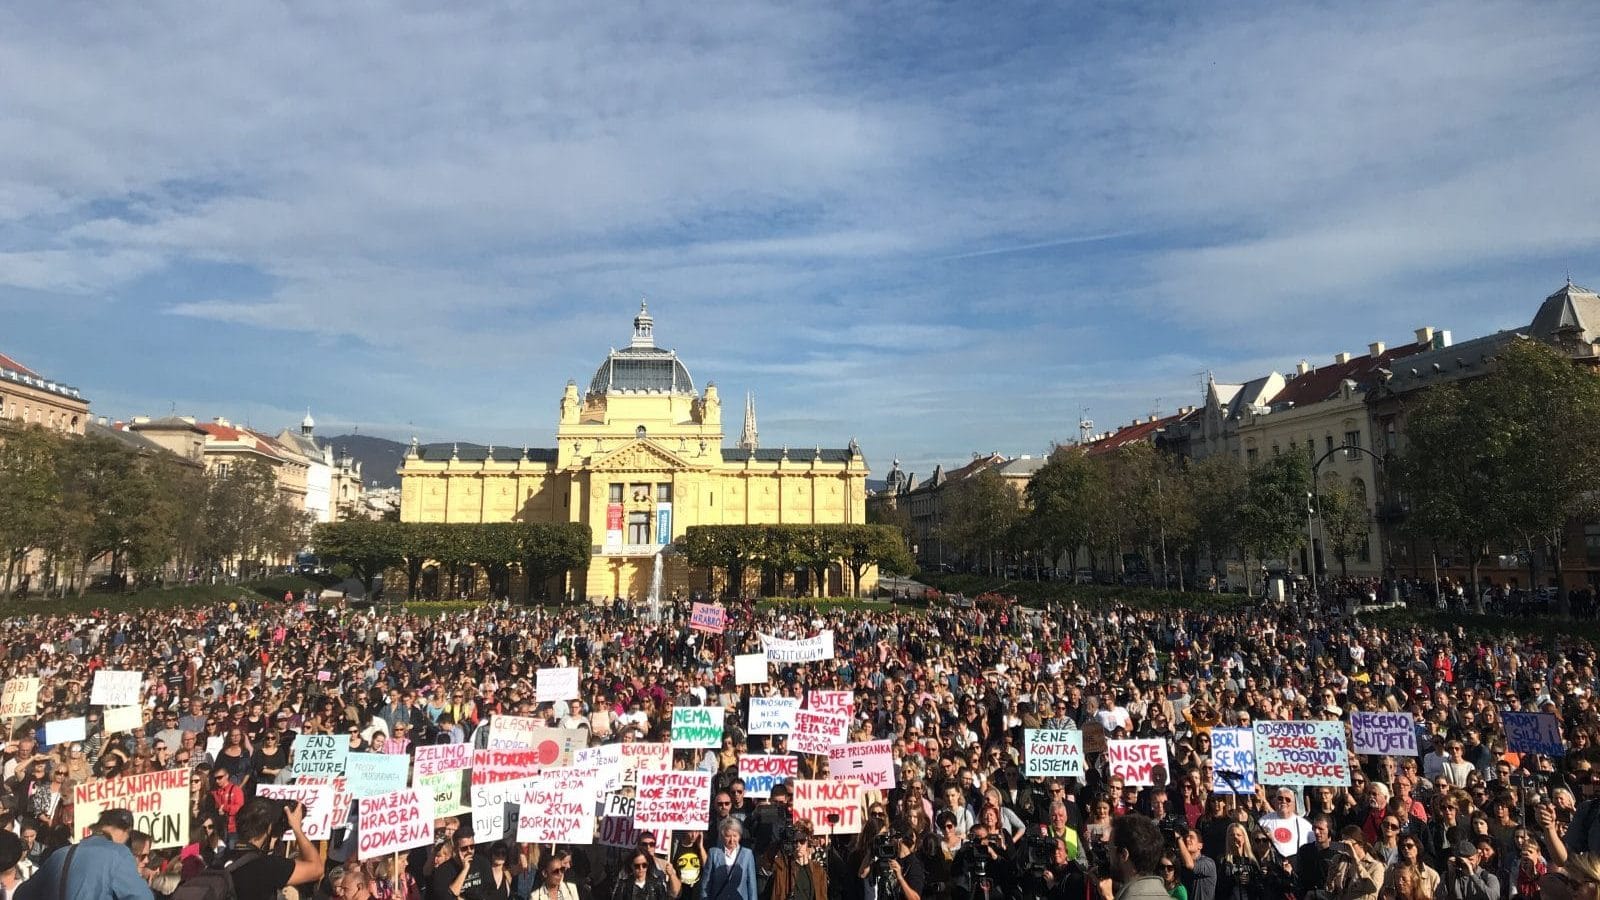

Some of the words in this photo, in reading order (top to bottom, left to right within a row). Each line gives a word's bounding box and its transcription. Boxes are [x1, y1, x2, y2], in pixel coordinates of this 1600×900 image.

[674, 709, 711, 725] NEMA
[1256, 723, 1316, 737] ODGAJAJMO
[306, 737, 335, 748] END
[1212, 731, 1239, 749] BORI
[1321, 737, 1342, 751] DA
[300, 750, 336, 761] RAPE
[416, 744, 465, 762] ŽELIMO
[475, 750, 490, 765] NI
[829, 748, 845, 759] BEZ
[848, 744, 891, 758] PRISTANKA
[1031, 743, 1079, 756] KONTRA
[1109, 744, 1162, 763] NISTE
[1278, 748, 1337, 765] POŠTUJU
[294, 757, 348, 773] CULTURE!
[634, 757, 649, 769] JE
[740, 757, 798, 776] DJEVOJKE
[1030, 759, 1079, 772] SISTEMA
[1214, 750, 1231, 769] SE
[1234, 750, 1253, 768] KAO
[419, 763, 433, 775] SE
[1264, 762, 1345, 779] DJEVOJČICE
[76, 768, 190, 805] NEKAŽNJAVANJE
[642, 774, 709, 788] INSTITUCIJE
[524, 790, 564, 804] NISAM
[640, 788, 663, 800] KOJE
[796, 784, 811, 800] NI
[361, 792, 418, 815] SNAŽNA
[361, 807, 419, 830] HRABRA
[476, 815, 502, 836] nije
[519, 817, 580, 833] BORKINJA
[360, 823, 430, 852] ODVAŽNA
